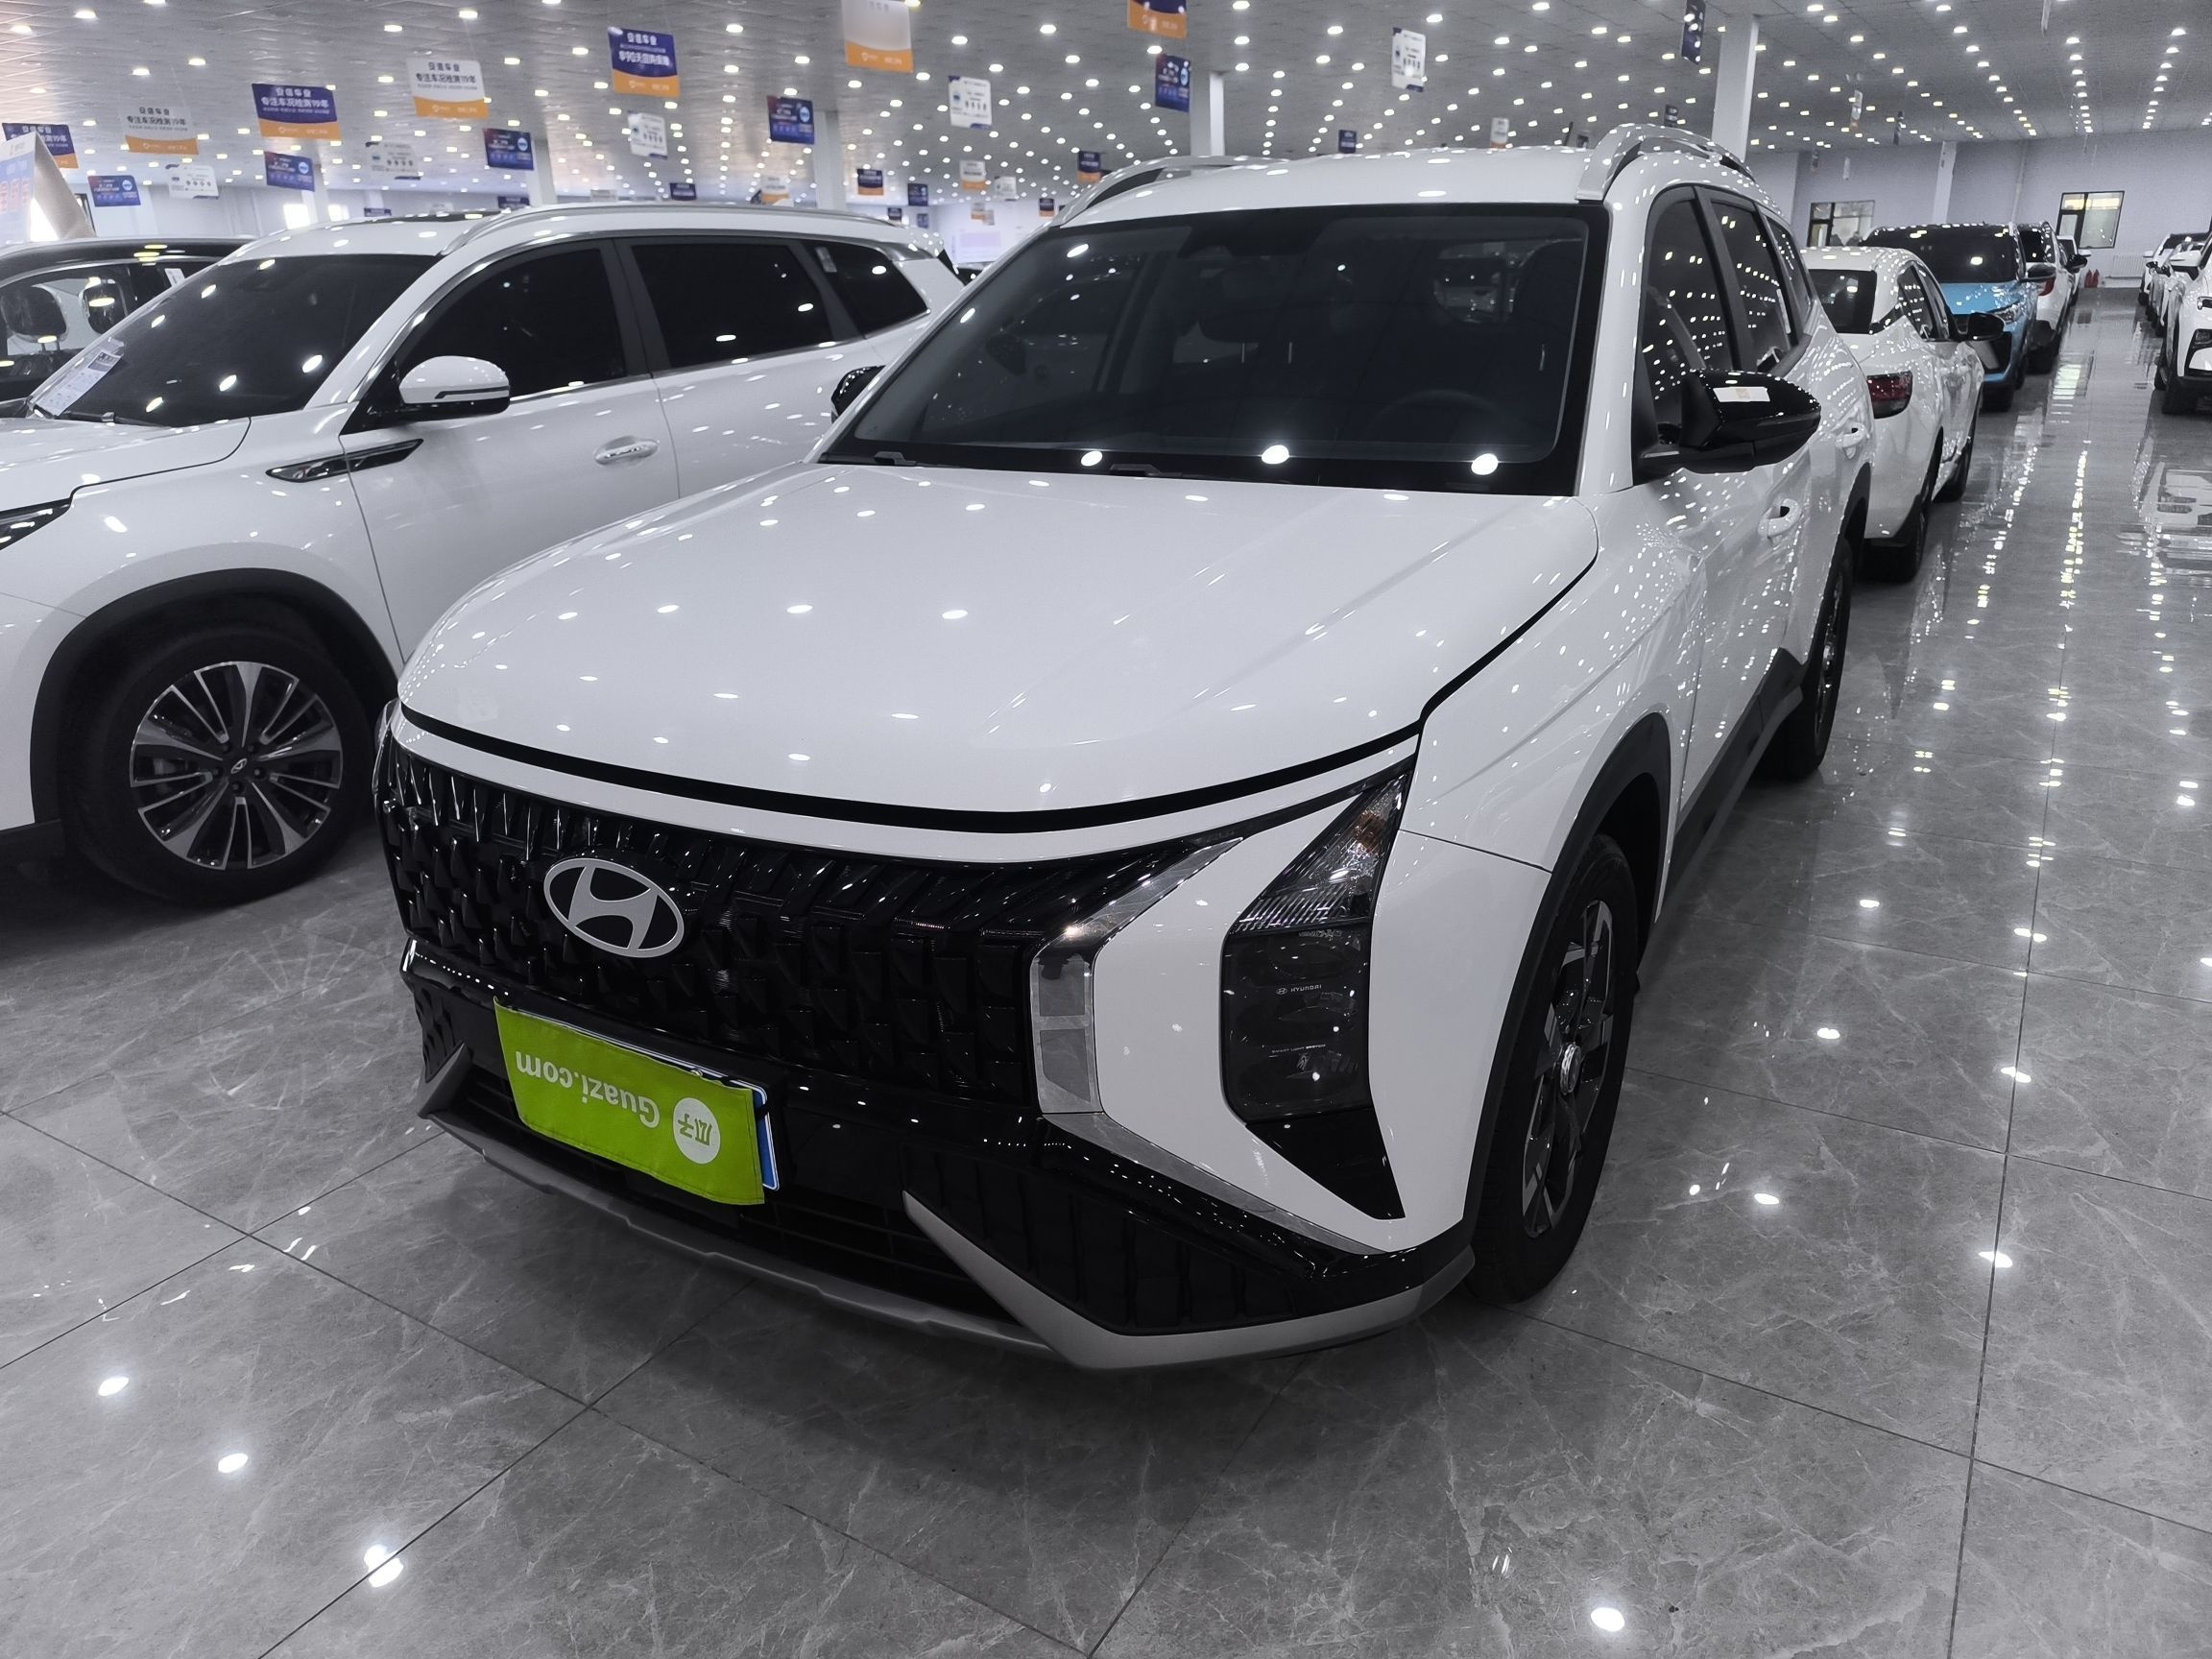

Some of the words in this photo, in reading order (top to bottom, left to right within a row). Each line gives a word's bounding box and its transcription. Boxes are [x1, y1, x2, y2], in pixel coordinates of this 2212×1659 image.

[1290, 984, 1322, 993] HYUNDAI
[515, 1050, 661, 1128] Guazi.com
[677, 1113, 713, 1146] 瓜子
